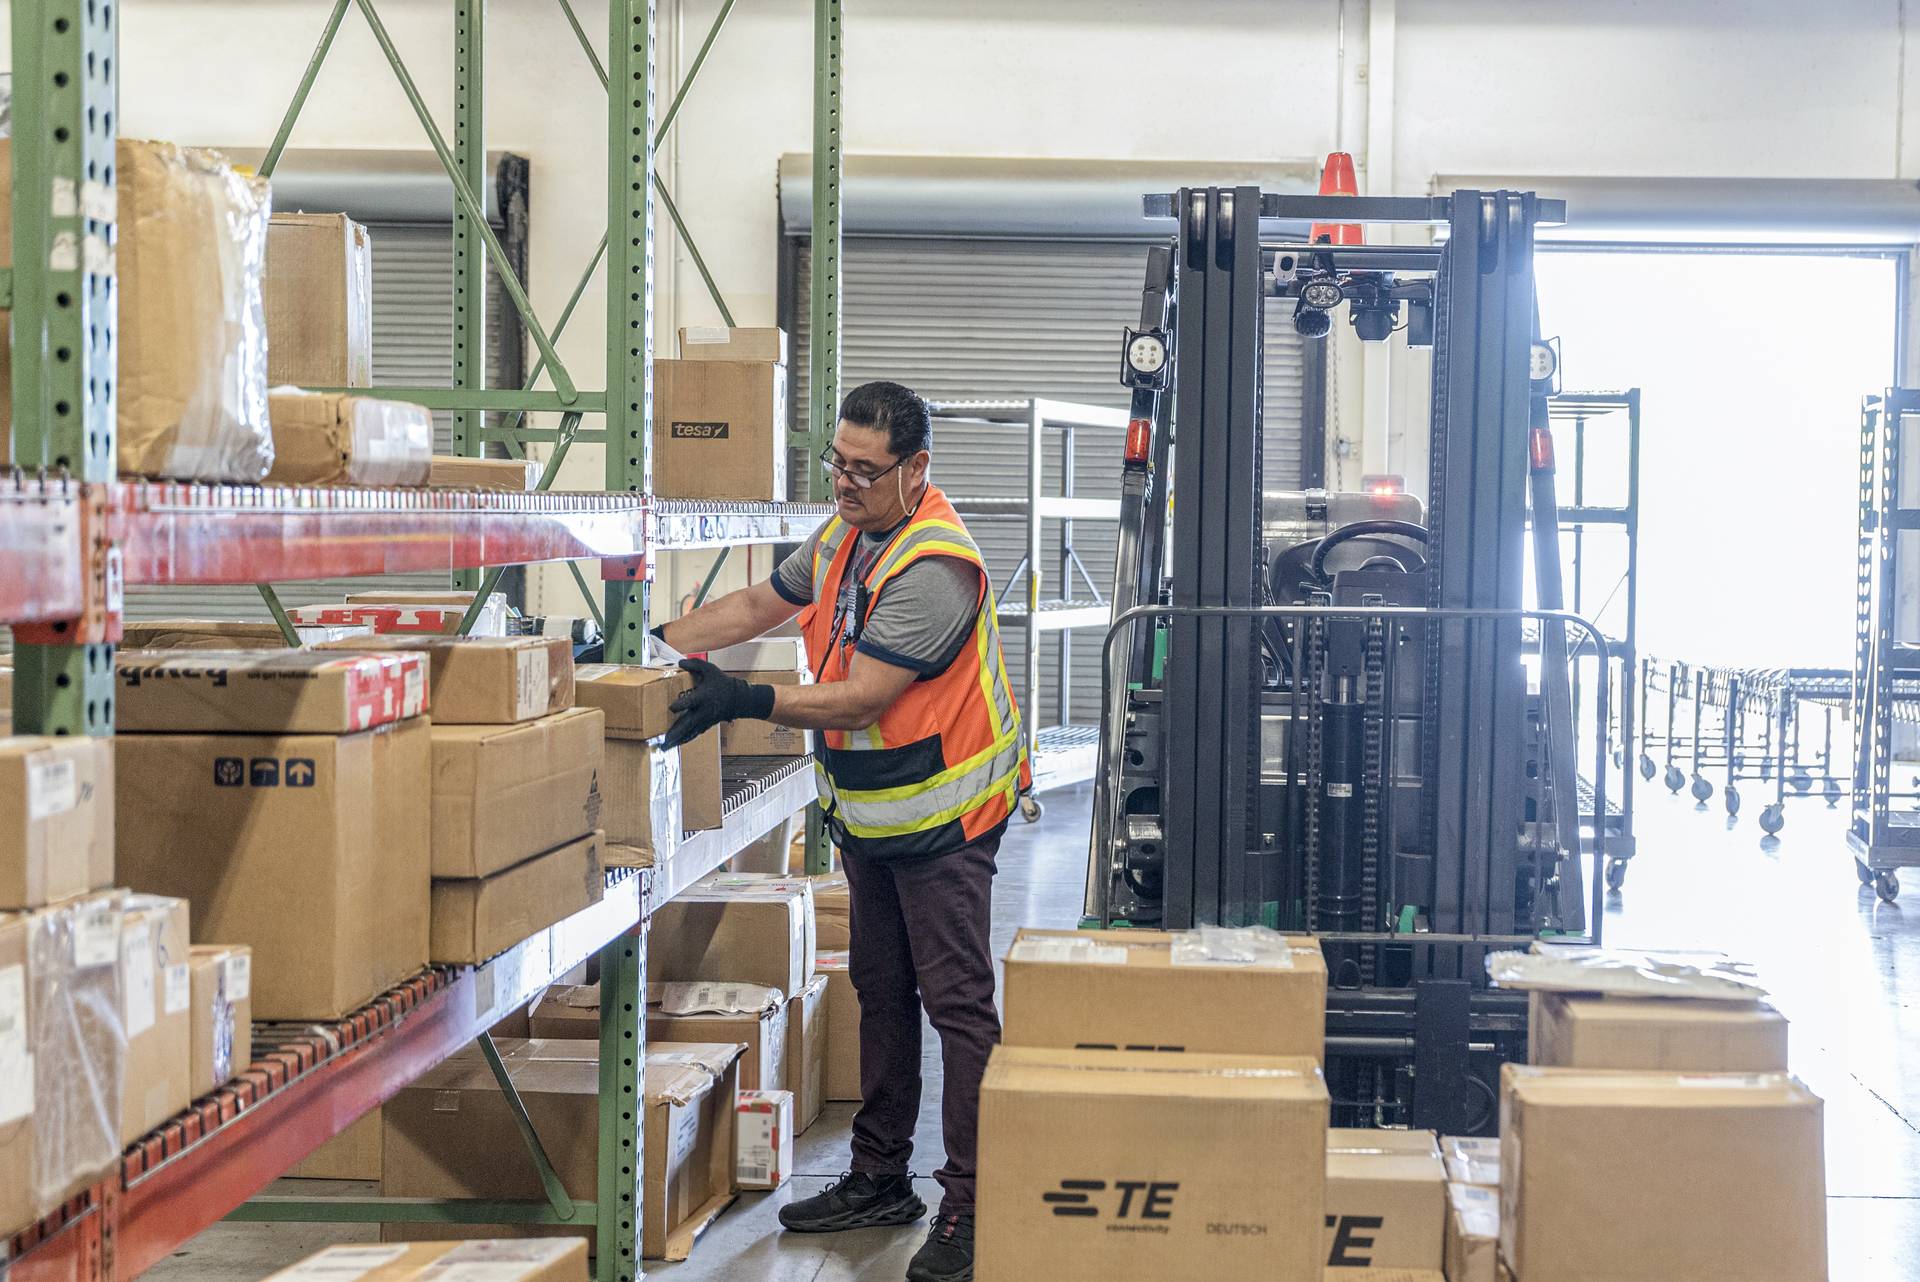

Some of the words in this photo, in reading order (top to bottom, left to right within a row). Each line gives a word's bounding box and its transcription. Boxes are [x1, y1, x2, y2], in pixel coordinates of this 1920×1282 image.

[674, 423, 712, 436] tesa
[1114, 1181, 1180, 1220] TE
[1325, 1215, 1384, 1267] E
